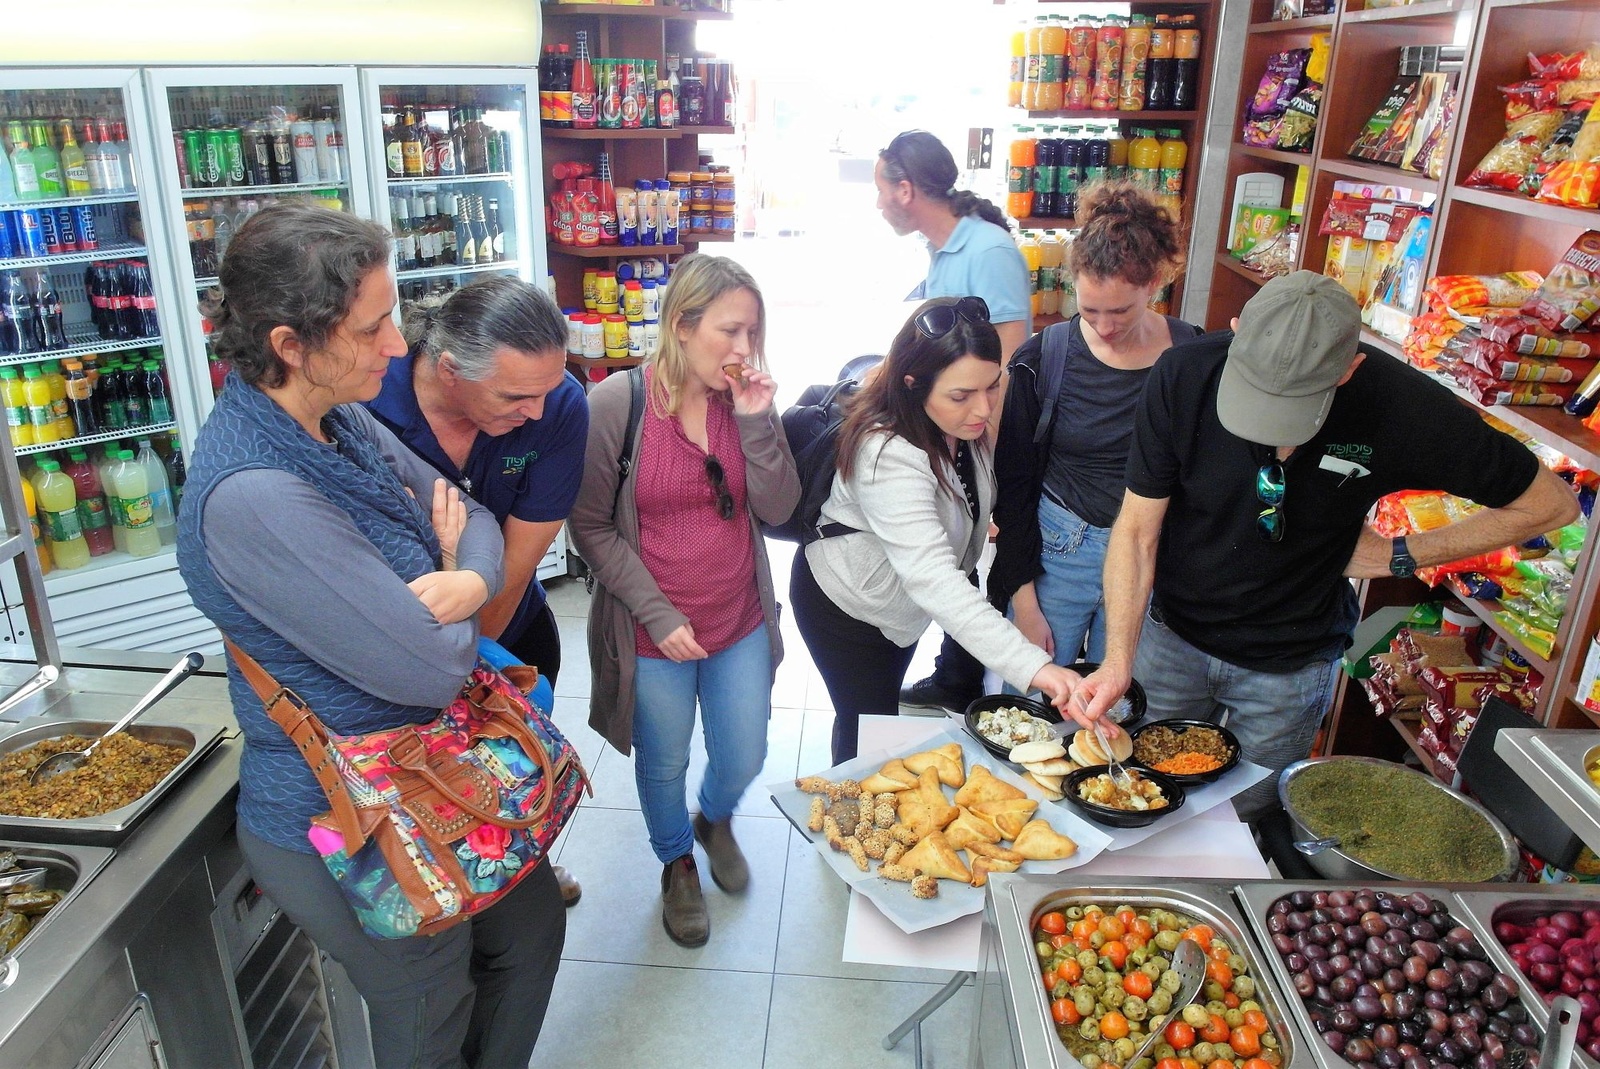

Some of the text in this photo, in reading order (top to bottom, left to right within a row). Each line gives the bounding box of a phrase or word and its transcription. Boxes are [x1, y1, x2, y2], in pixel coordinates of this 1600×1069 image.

[22, 214, 38, 229] XL
[60, 211, 77, 244] BLU
[82, 210, 97, 242] BLU
[1563, 248, 1600, 273] PERFECTO
